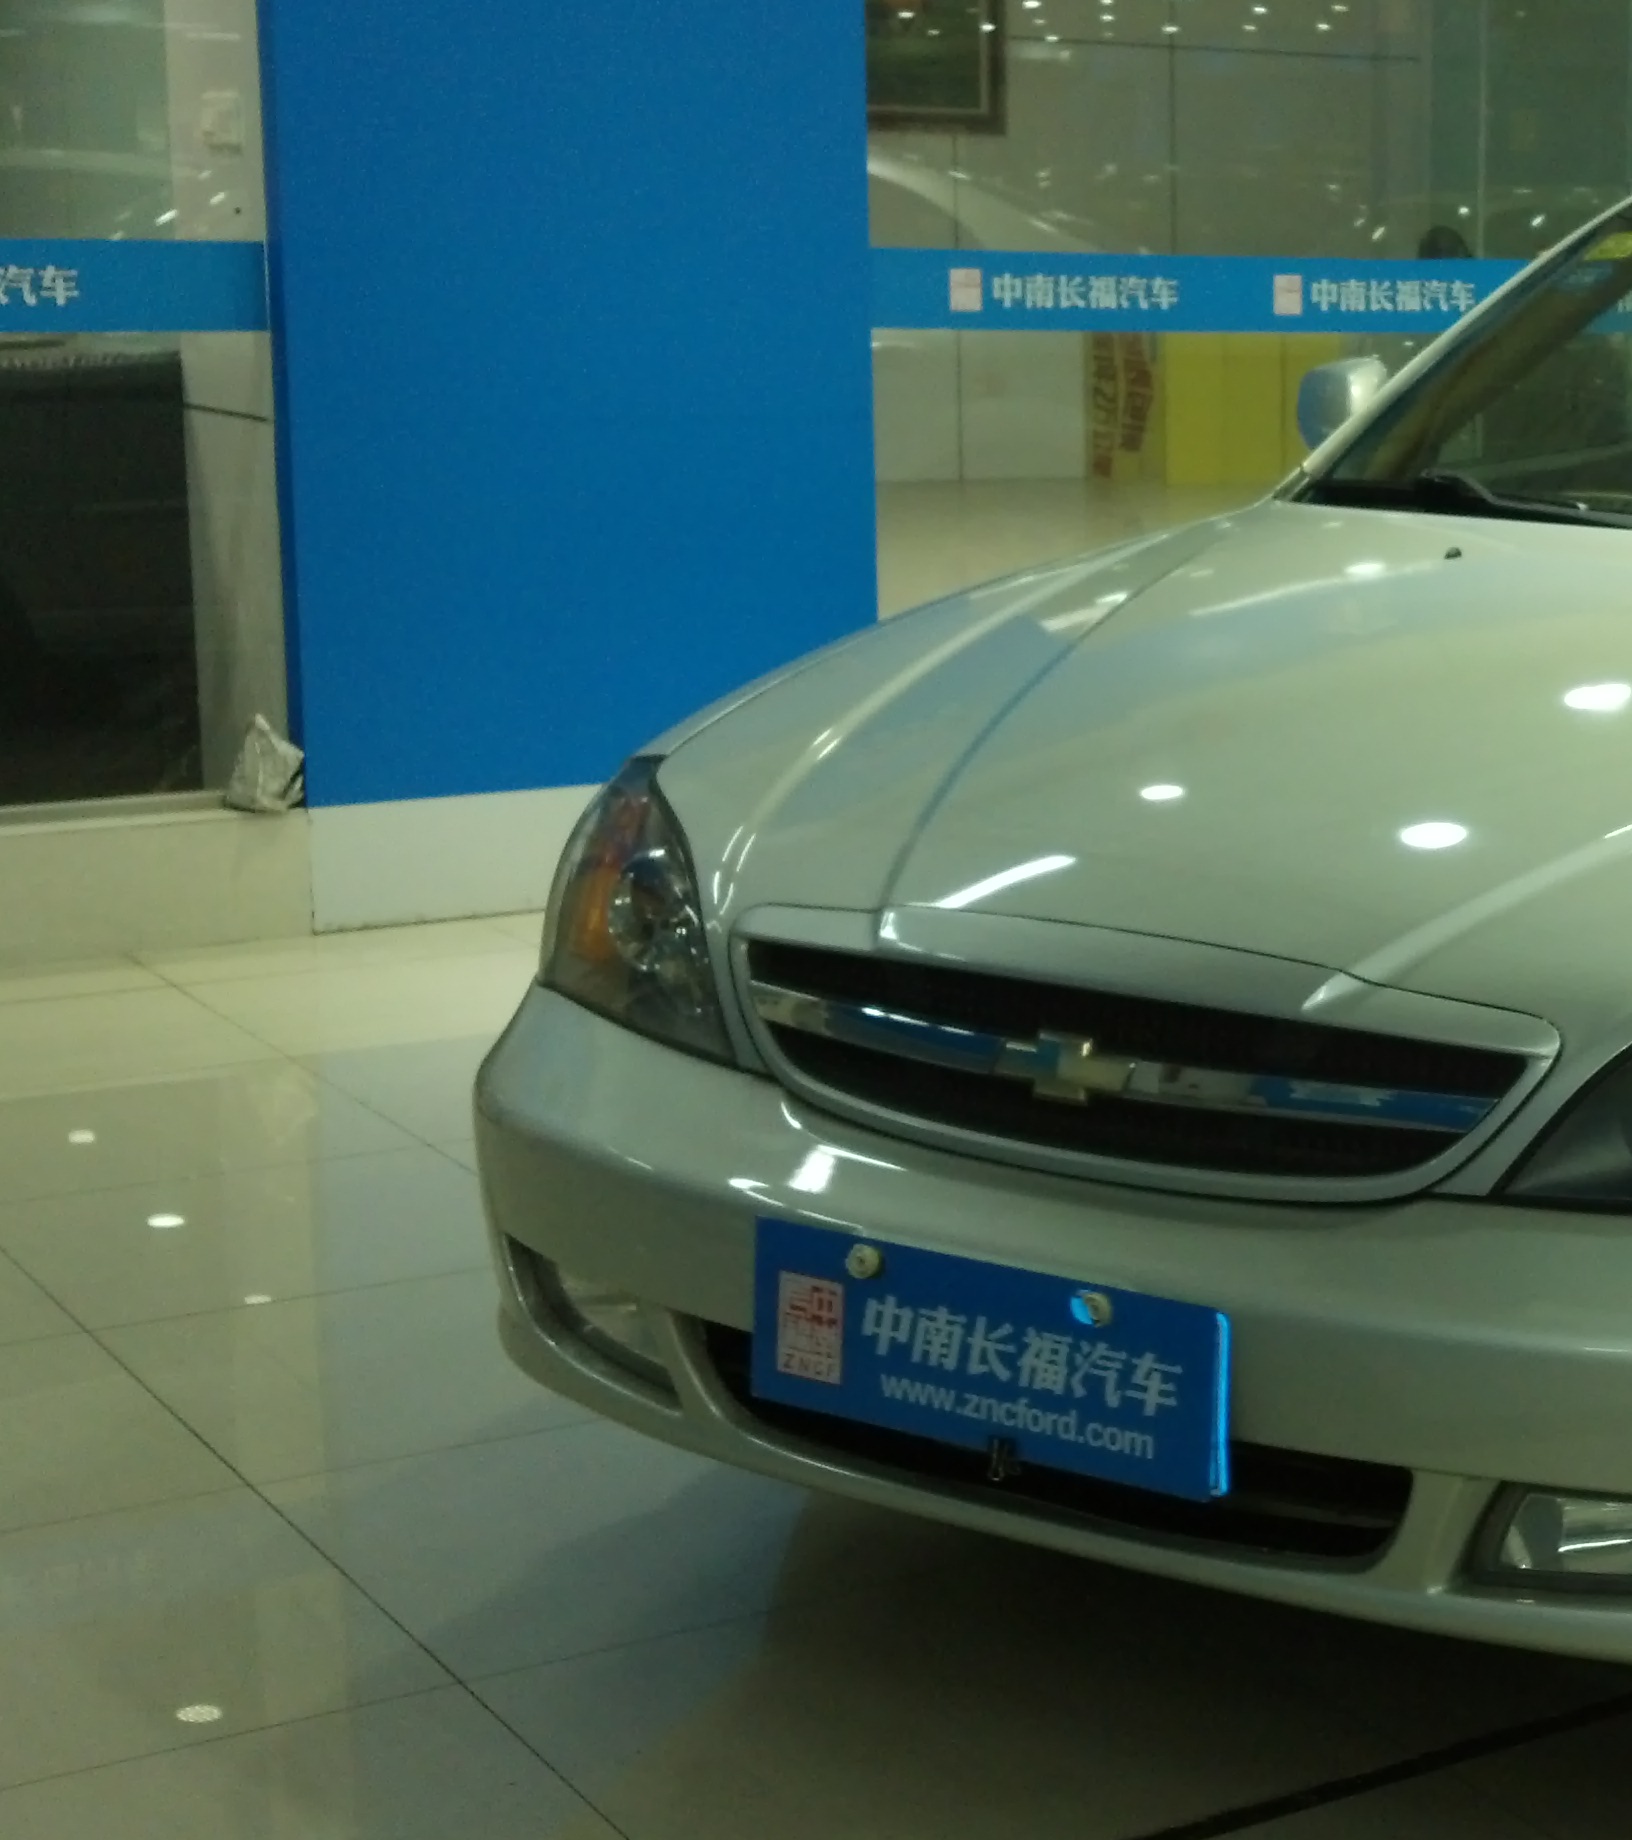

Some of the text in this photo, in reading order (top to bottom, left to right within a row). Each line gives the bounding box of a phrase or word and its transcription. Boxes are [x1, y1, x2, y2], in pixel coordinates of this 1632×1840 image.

[992, 273, 1179, 309] 中南长福汽车
[1311, 279, 1475, 312] 中南长福汽车
[861, 1294, 1183, 1417] 中南长福汽车
[880, 1373, 1155, 1460] www.zncford.com
